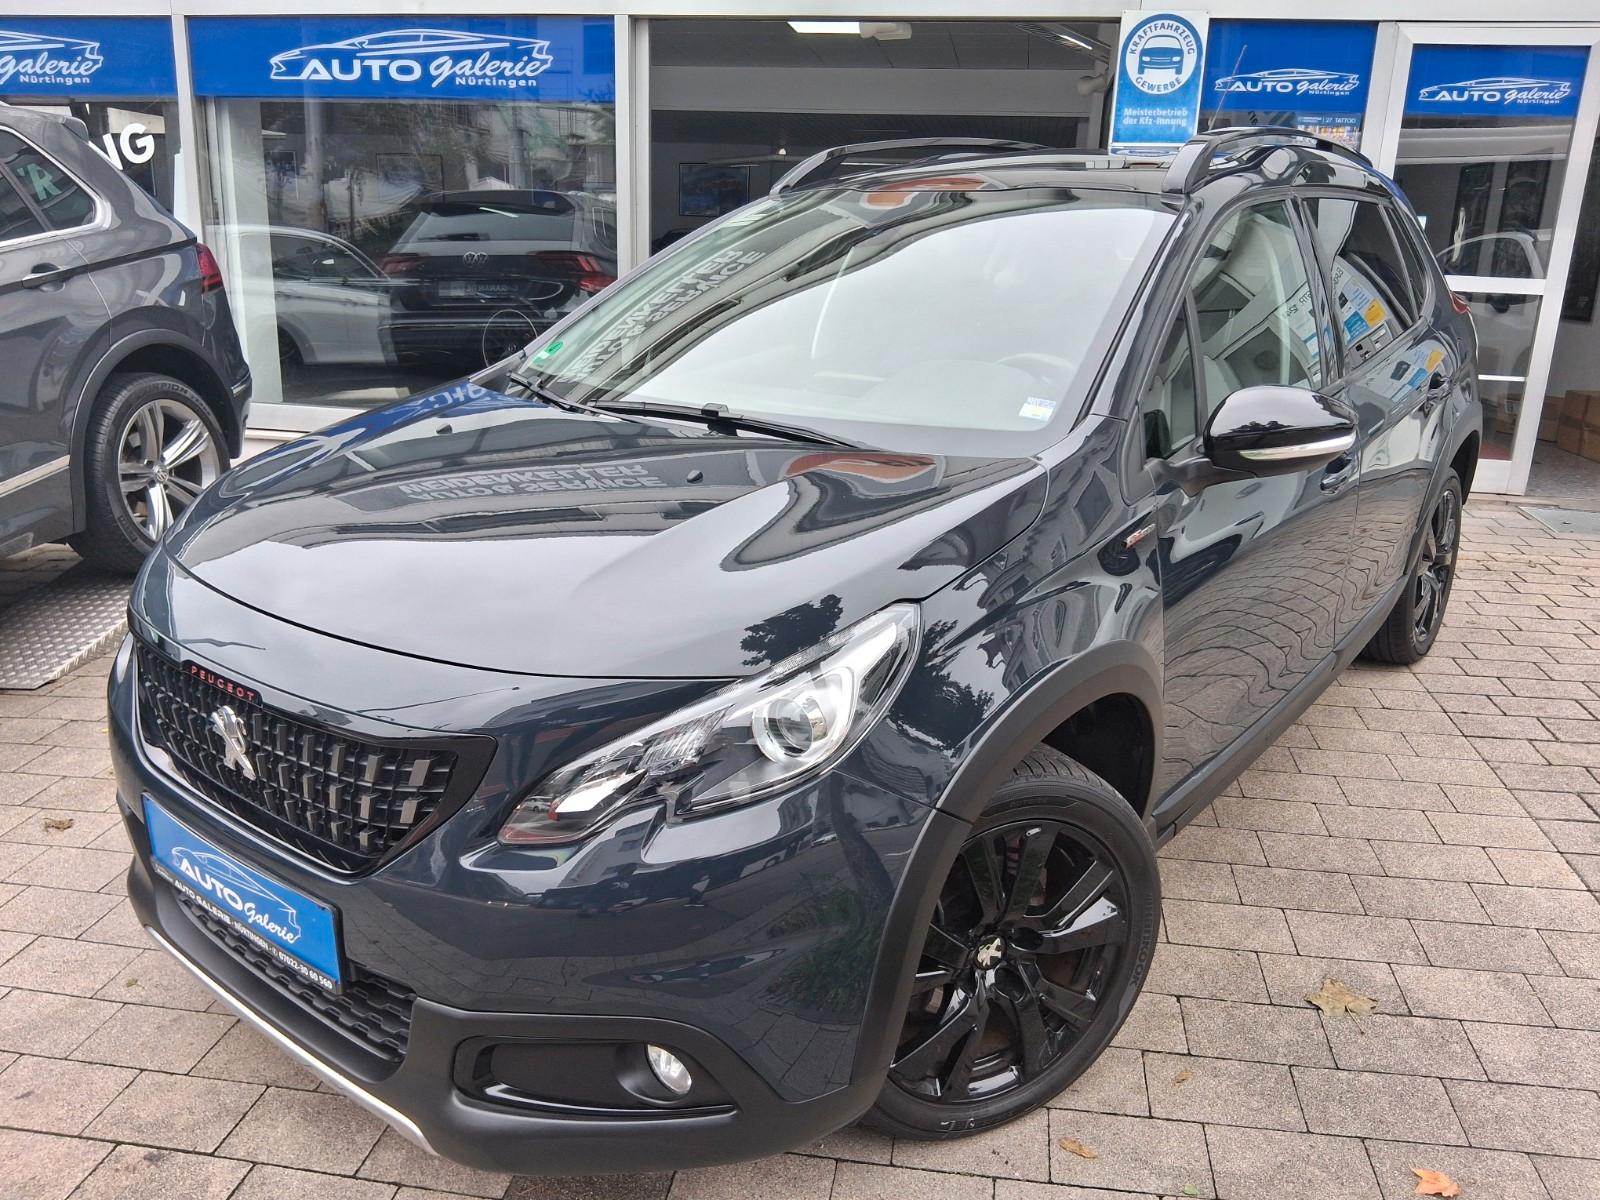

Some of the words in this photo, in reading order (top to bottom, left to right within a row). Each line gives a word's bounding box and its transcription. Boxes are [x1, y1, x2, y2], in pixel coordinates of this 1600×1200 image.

[1129, 22, 1196, 55] KRAFTFAHRZEUG
[301, 58, 422, 82] AUTO
[429, 51, 545, 88] galerie
[19, 74, 91, 86] Nürtingen
[455, 75, 537, 89] Nürtingen
[1135, 76, 1182, 92] GEWERBE
[1230, 81, 1294, 93] AUTO
[1296, 79, 1355, 96] galerie
[1435, 90, 1501, 102] AUTO
[1504, 88, 1565, 105] galerie
[1123, 107, 1188, 116] Meisterbetrieb
[1122, 117, 1137, 125] der
[1138, 117, 1187, 127] Kfz-Innung
[191, 665, 255, 701] PEUGEOT
[174, 880, 195, 899] AUTO
[196, 895, 231, 925] GALERIE
[178, 857, 244, 911] AUTO
[244, 902, 298, 944] Galerie
